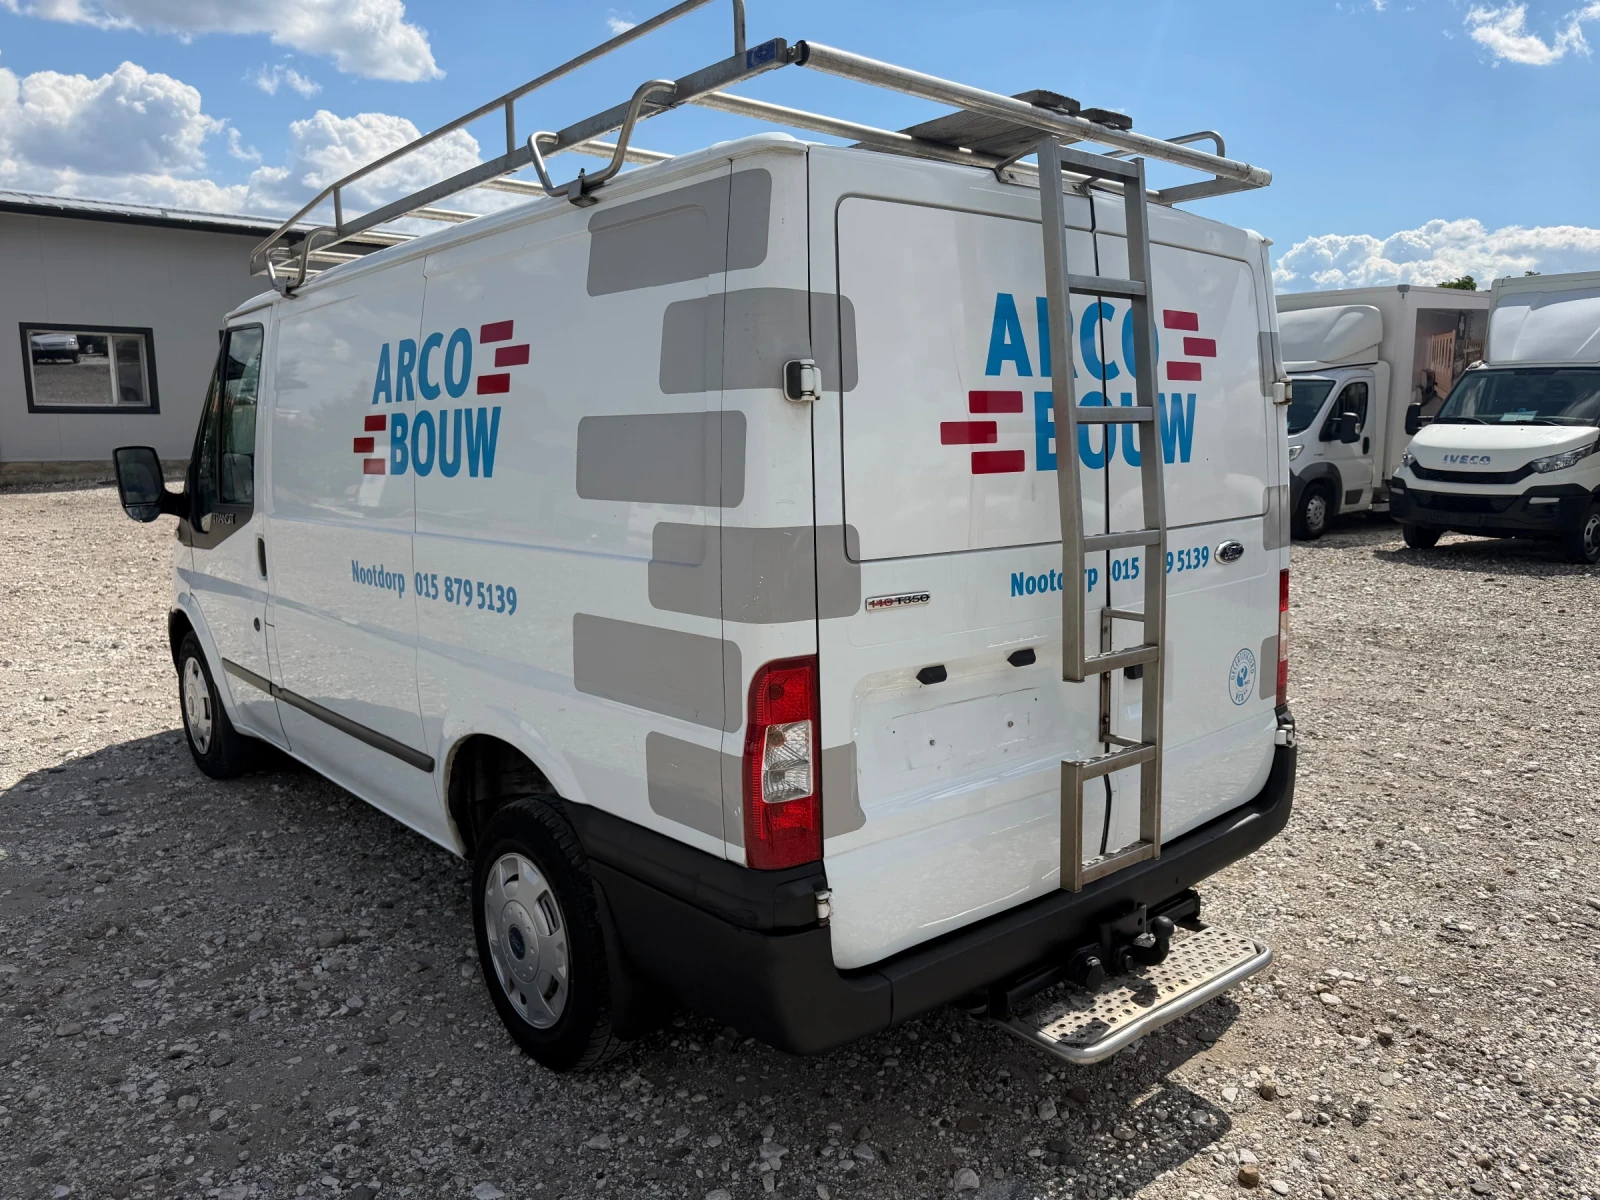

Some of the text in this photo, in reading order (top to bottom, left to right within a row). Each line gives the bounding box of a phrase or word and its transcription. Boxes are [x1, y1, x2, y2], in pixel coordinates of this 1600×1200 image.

[372, 327, 473, 404] ARCO
[390, 406, 502, 478] BOUW
[1442, 454, 1491, 465] IVECO
[351, 560, 517, 616] Nootdorp 015 879 5139
[1010, 568, 1098, 597] Nootp
[1112, 557, 1139, 582] 015
[1177, 545, 1209, 572] 5139
[895, 593, 930, 605] T350
